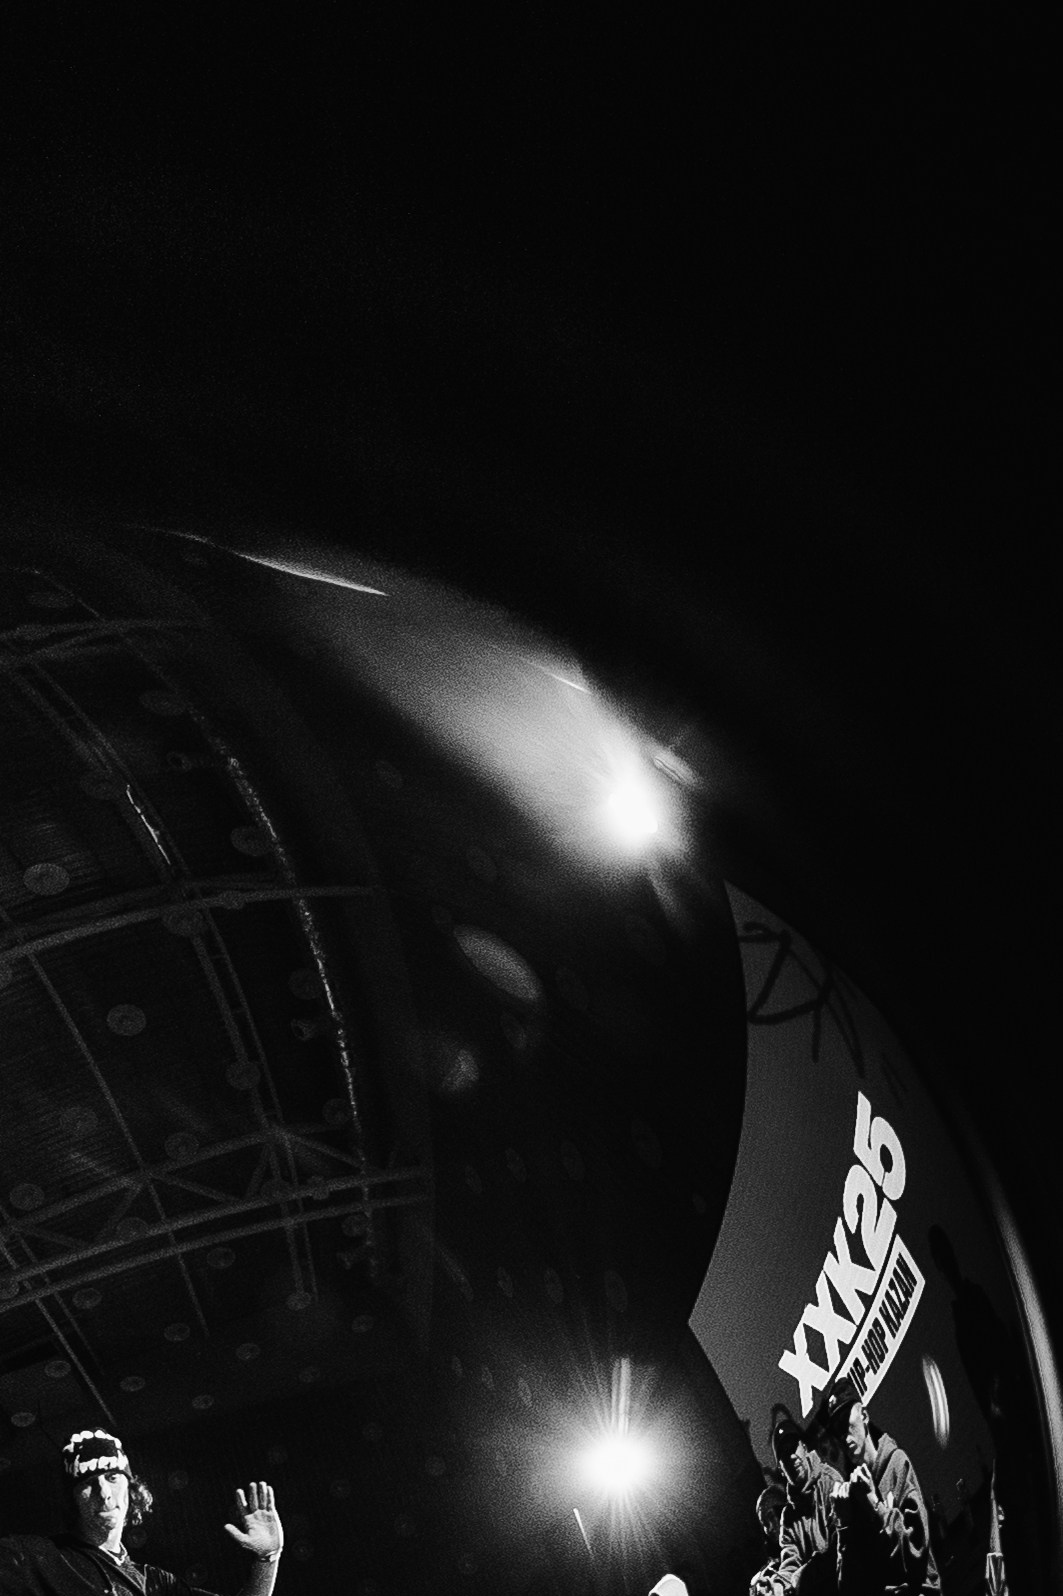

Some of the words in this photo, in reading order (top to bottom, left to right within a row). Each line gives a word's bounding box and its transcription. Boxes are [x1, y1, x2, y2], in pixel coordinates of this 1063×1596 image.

[778, 1090, 906, 1418] XXK25
[847, 1317, 889, 1397] IP-HOP
[879, 1252, 918, 1339] KAZAN
